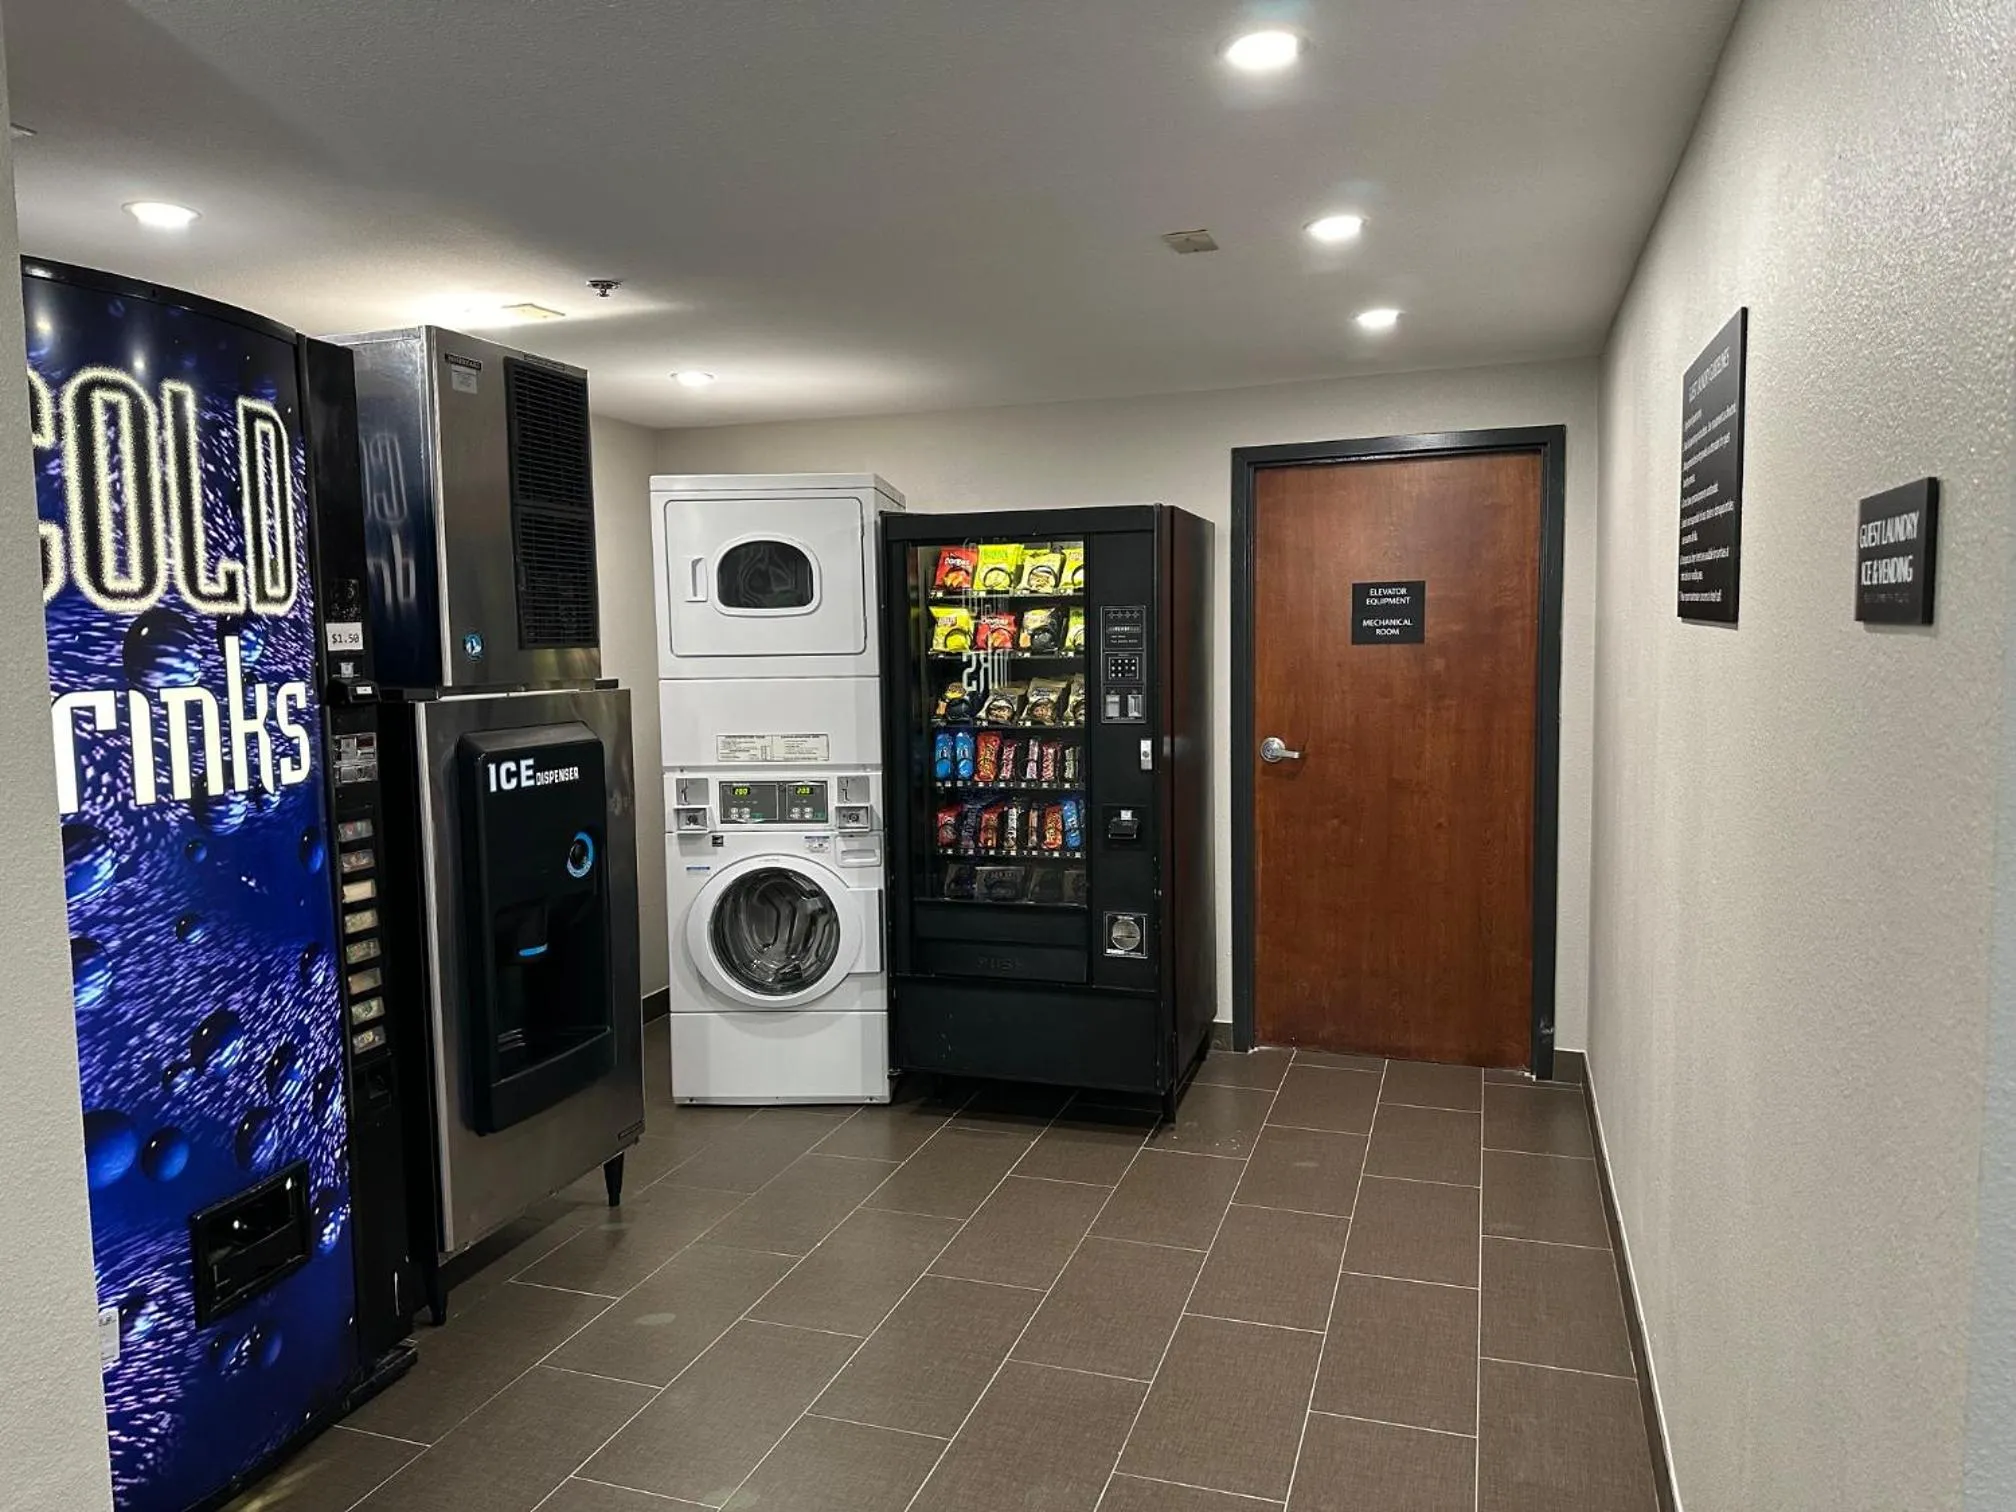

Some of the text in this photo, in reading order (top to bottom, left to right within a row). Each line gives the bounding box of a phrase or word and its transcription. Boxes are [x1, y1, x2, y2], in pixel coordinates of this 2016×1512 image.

[27, 366, 299, 617] OLD
[1860, 510, 1919, 548] GUEST LAUNDRY
[1861, 561, 1872, 585] ICE
[1879, 555, 1913, 584] VENDING
[1366, 597, 1411, 606] EQUIPMENT
[1369, 588, 1407, 596] ELEVATOR
[1362, 618, 1414, 627] MECHANICAL
[1375, 628, 1400, 636] ROOM
[331, 632, 360, 645] $1.50
[50, 635, 312, 814] rinks
[487, 757, 580, 792] ICE DISPENSER
